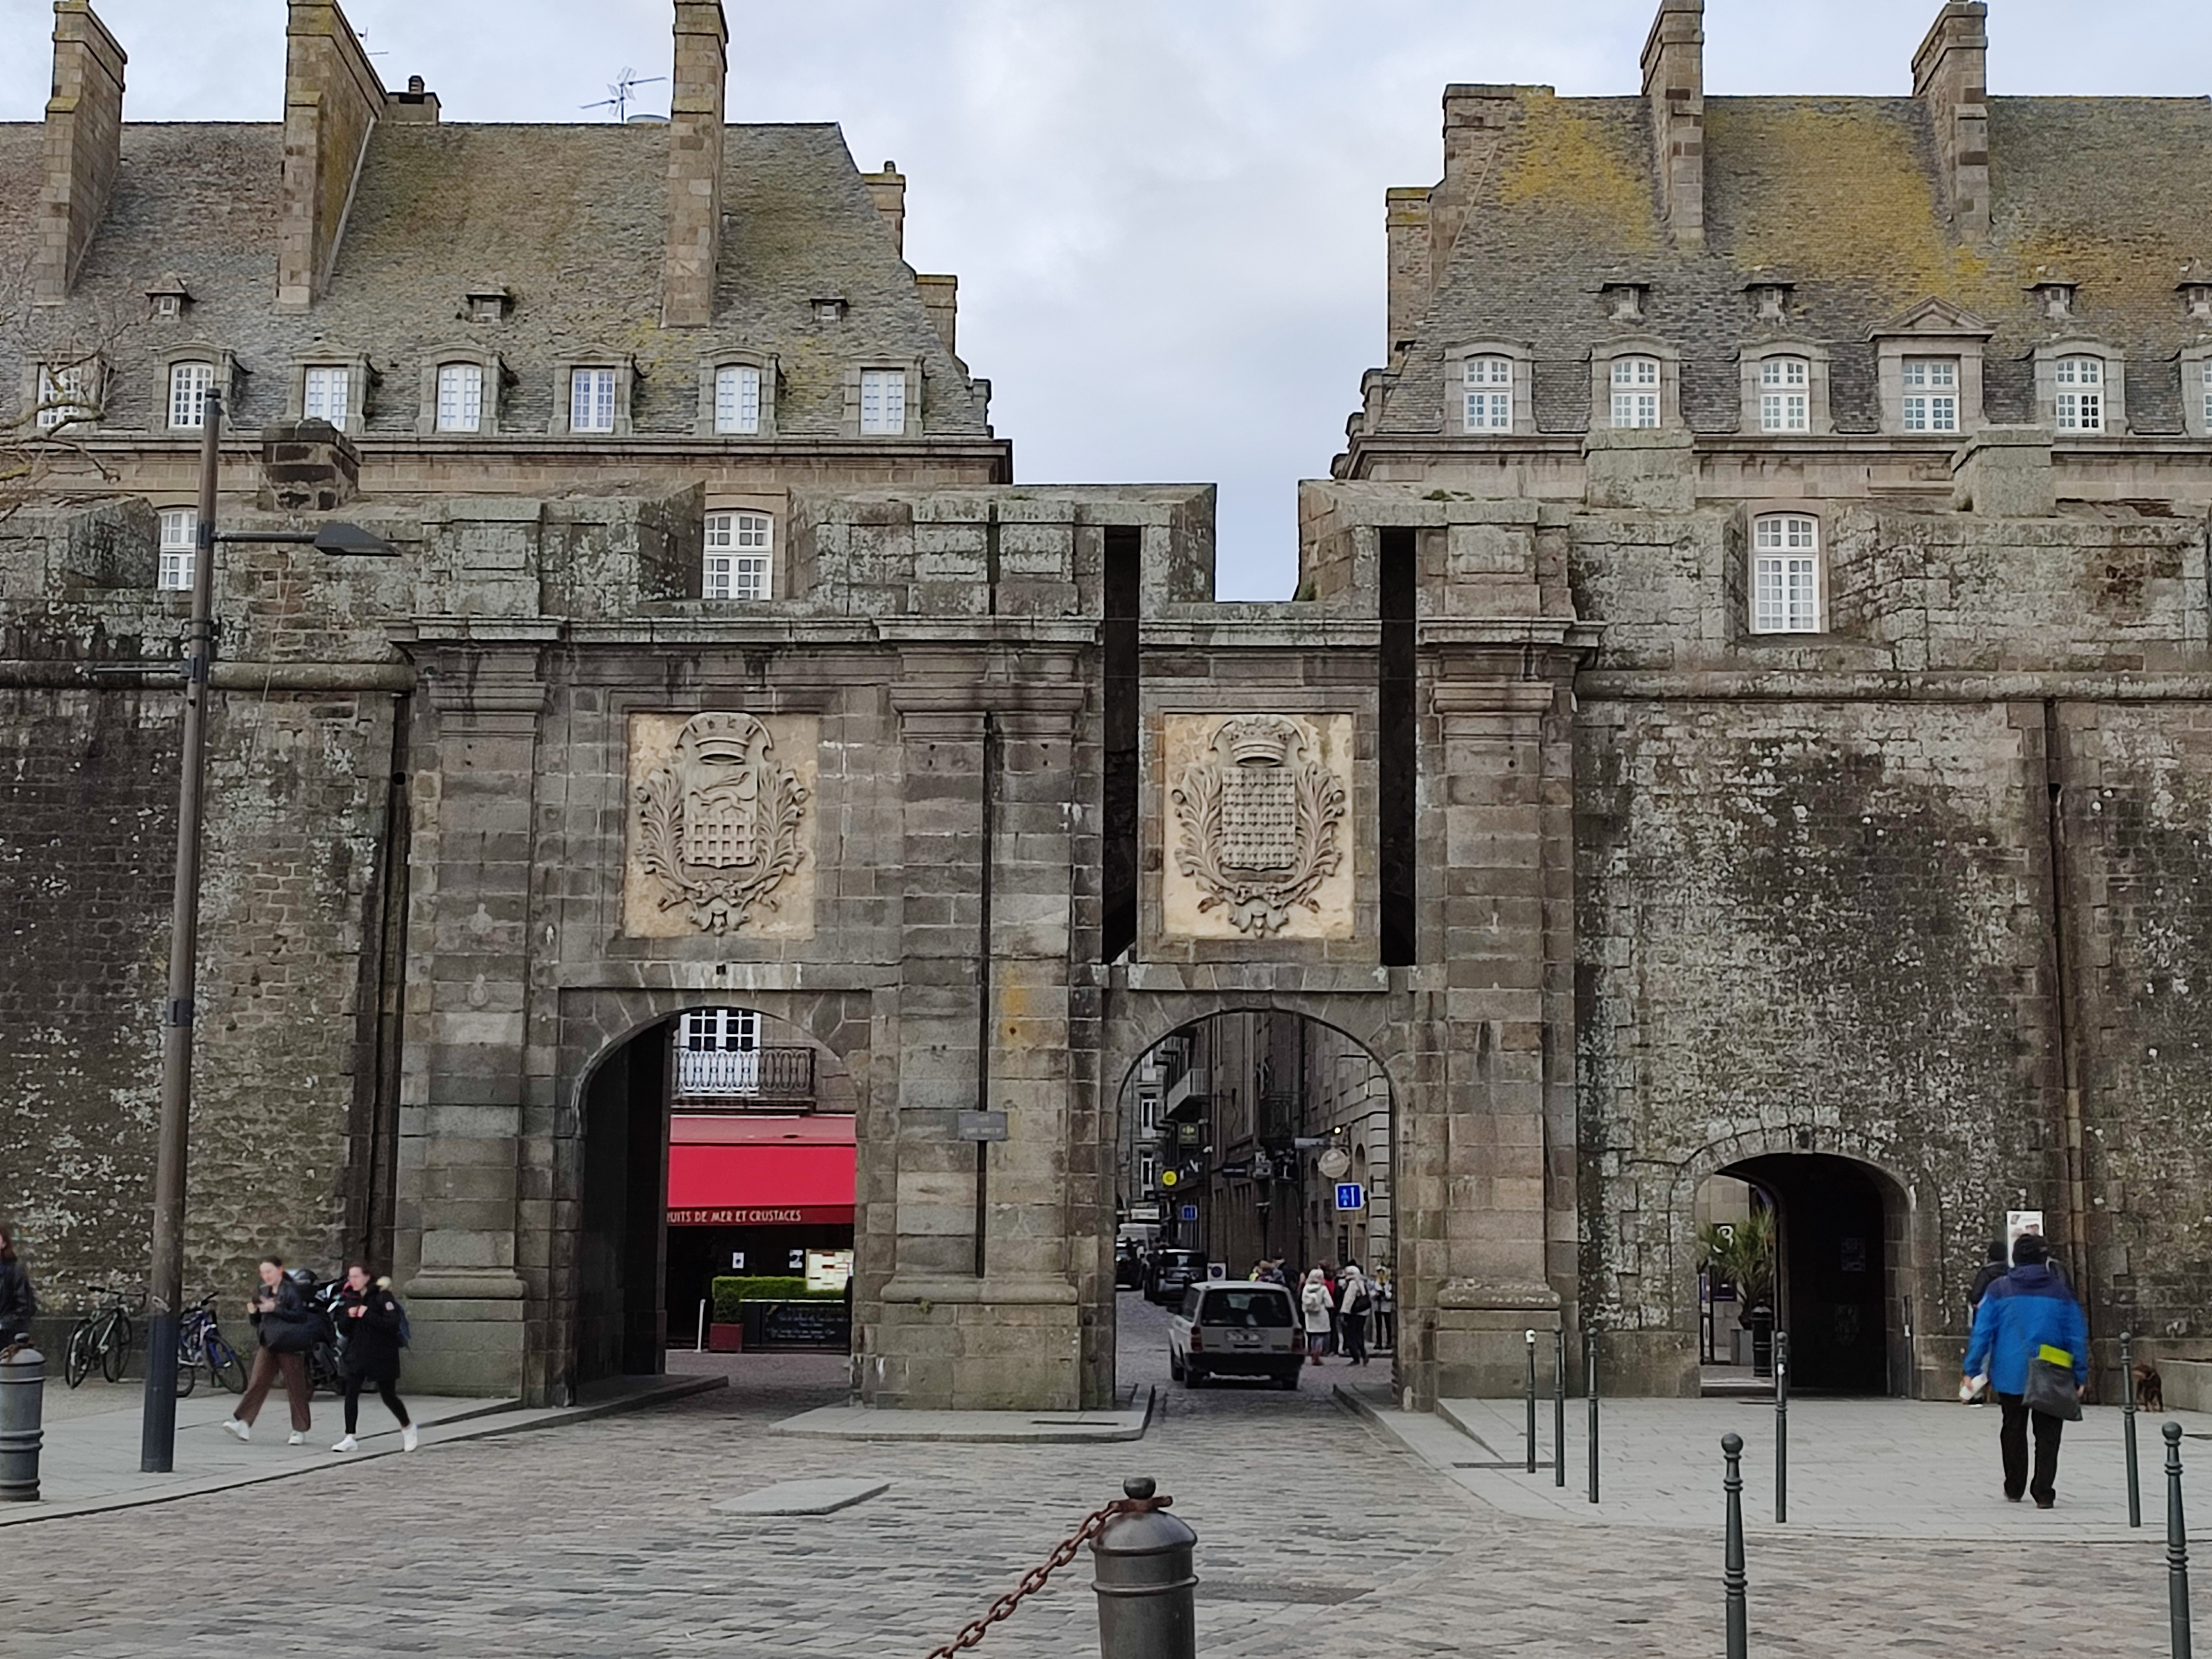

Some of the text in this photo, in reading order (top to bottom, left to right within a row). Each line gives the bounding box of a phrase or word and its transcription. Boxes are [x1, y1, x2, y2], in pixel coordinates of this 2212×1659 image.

[695, 1211, 708, 1222] DE
[710, 1211, 733, 1222] MER
[735, 1210, 747, 1222] ET
[749, 1209, 801, 1222] CRUSTACES
